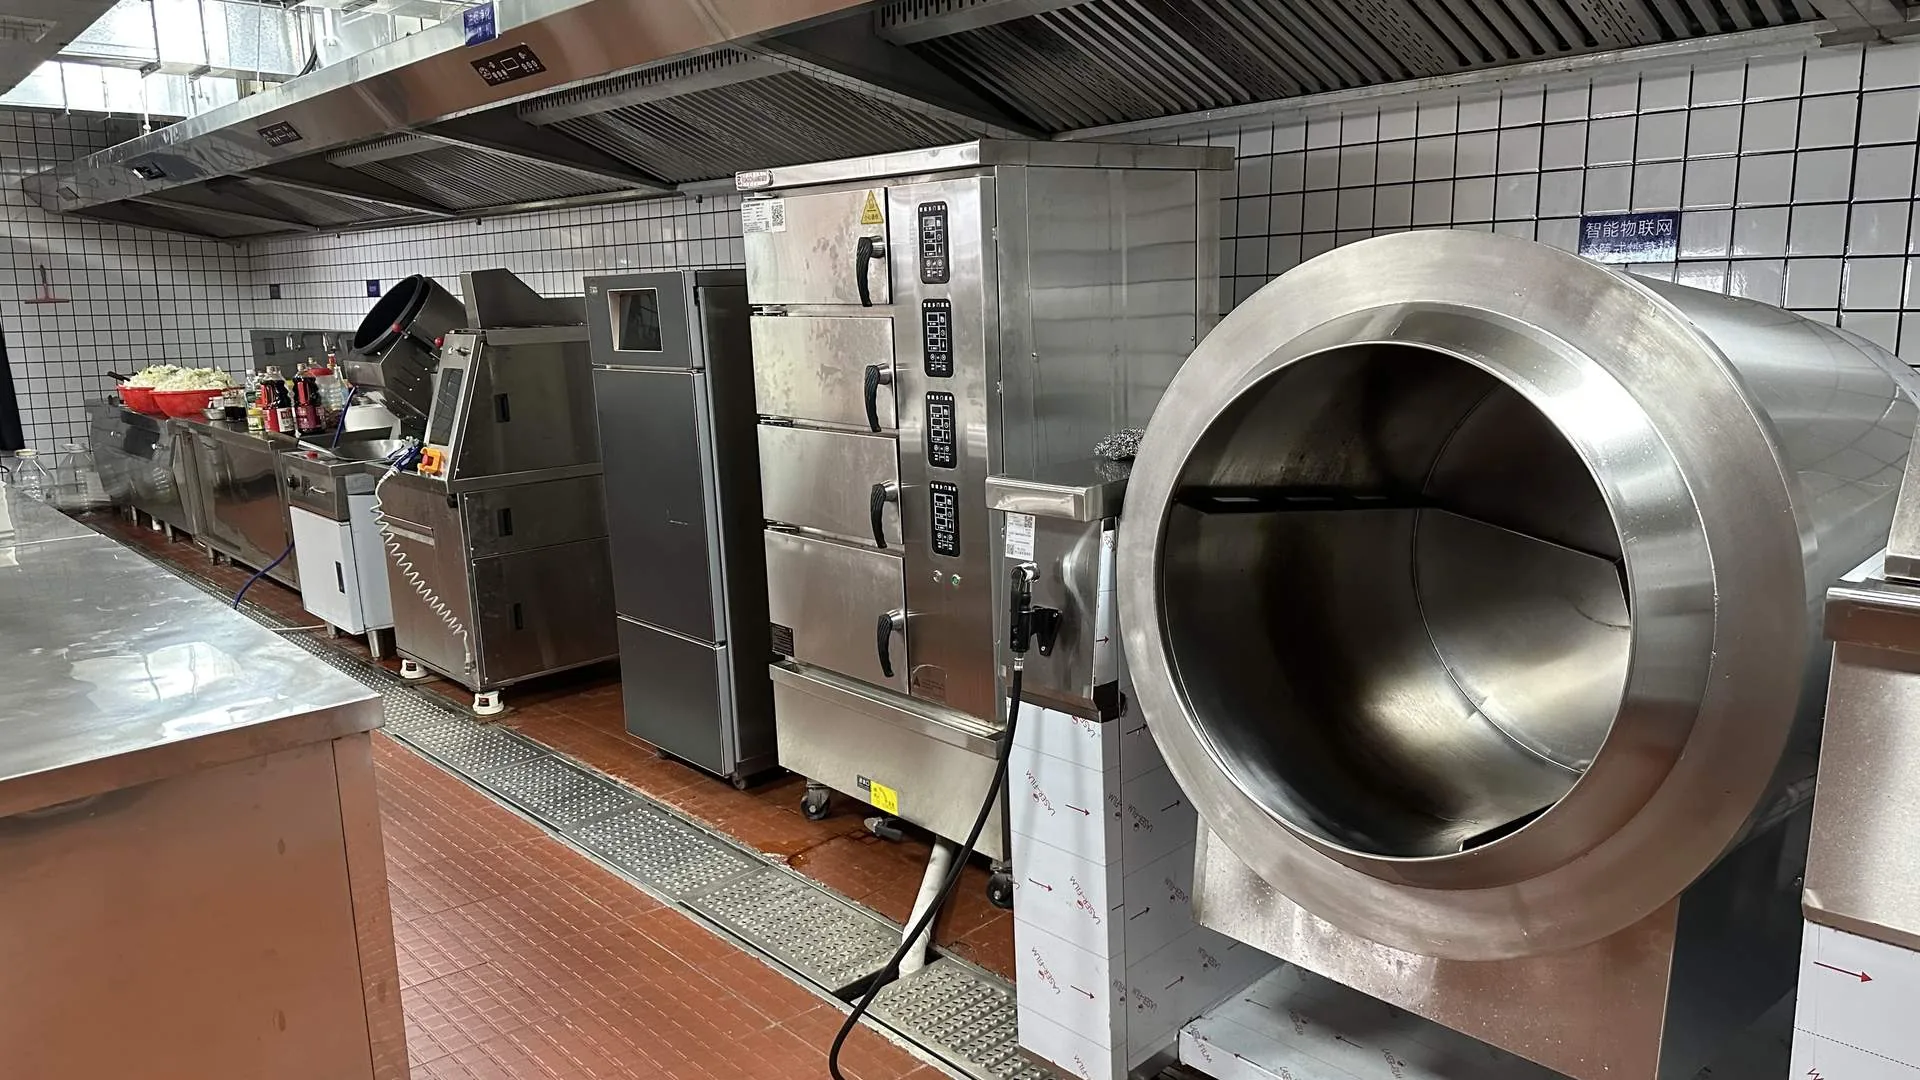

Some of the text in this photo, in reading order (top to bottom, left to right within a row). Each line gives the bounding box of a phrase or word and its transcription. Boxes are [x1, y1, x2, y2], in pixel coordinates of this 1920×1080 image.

[1586, 219, 1673, 238] 智能物联网
[1025, 769, 1056, 816] LASER-FILM
[1069, 875, 1101, 925] LASER-FILM
[1031, 946, 1061, 995] LASER-FILM
